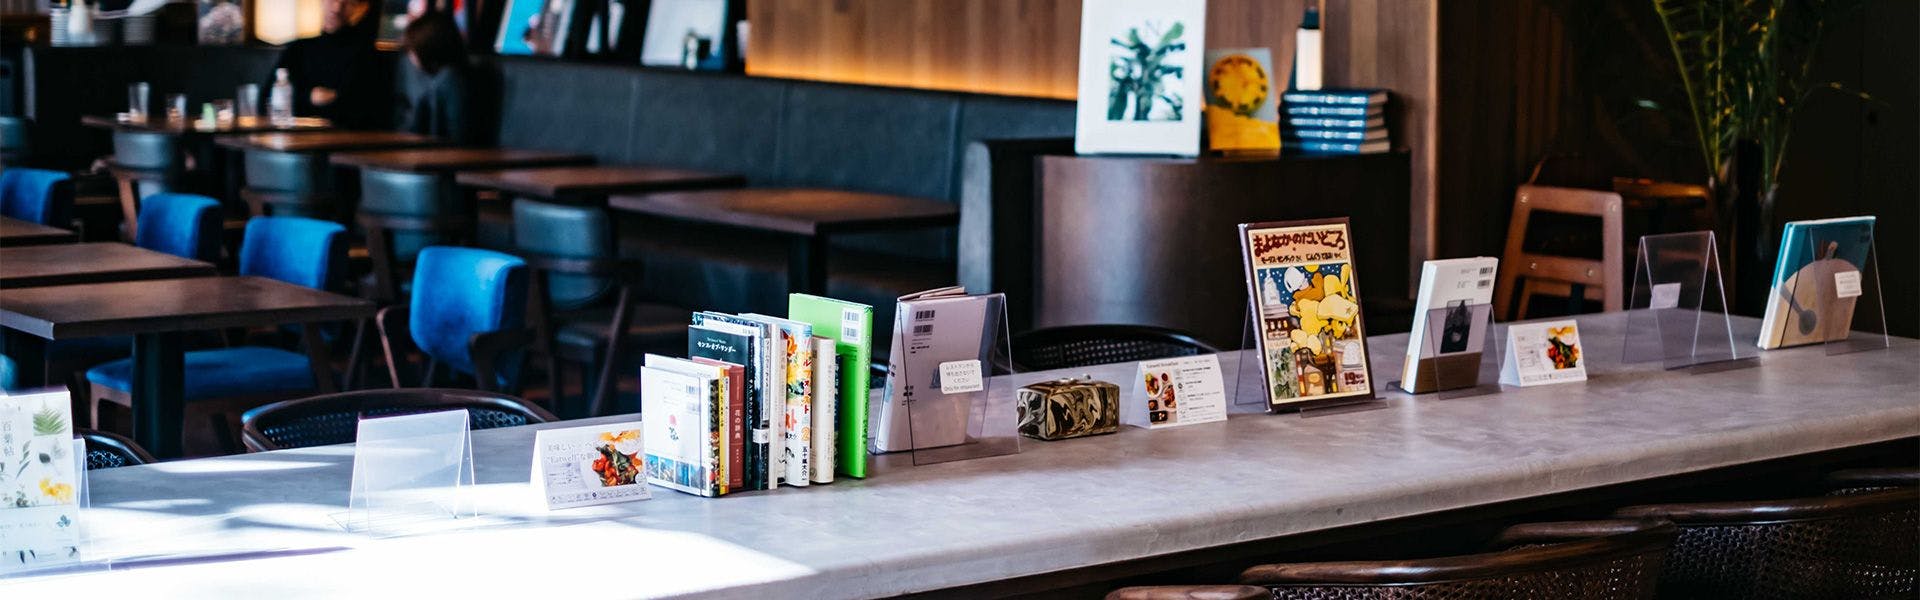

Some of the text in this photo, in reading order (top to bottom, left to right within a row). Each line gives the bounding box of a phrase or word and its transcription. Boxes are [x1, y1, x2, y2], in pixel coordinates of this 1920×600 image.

[1253, 231, 1346, 257] まよなかのだいどころ
